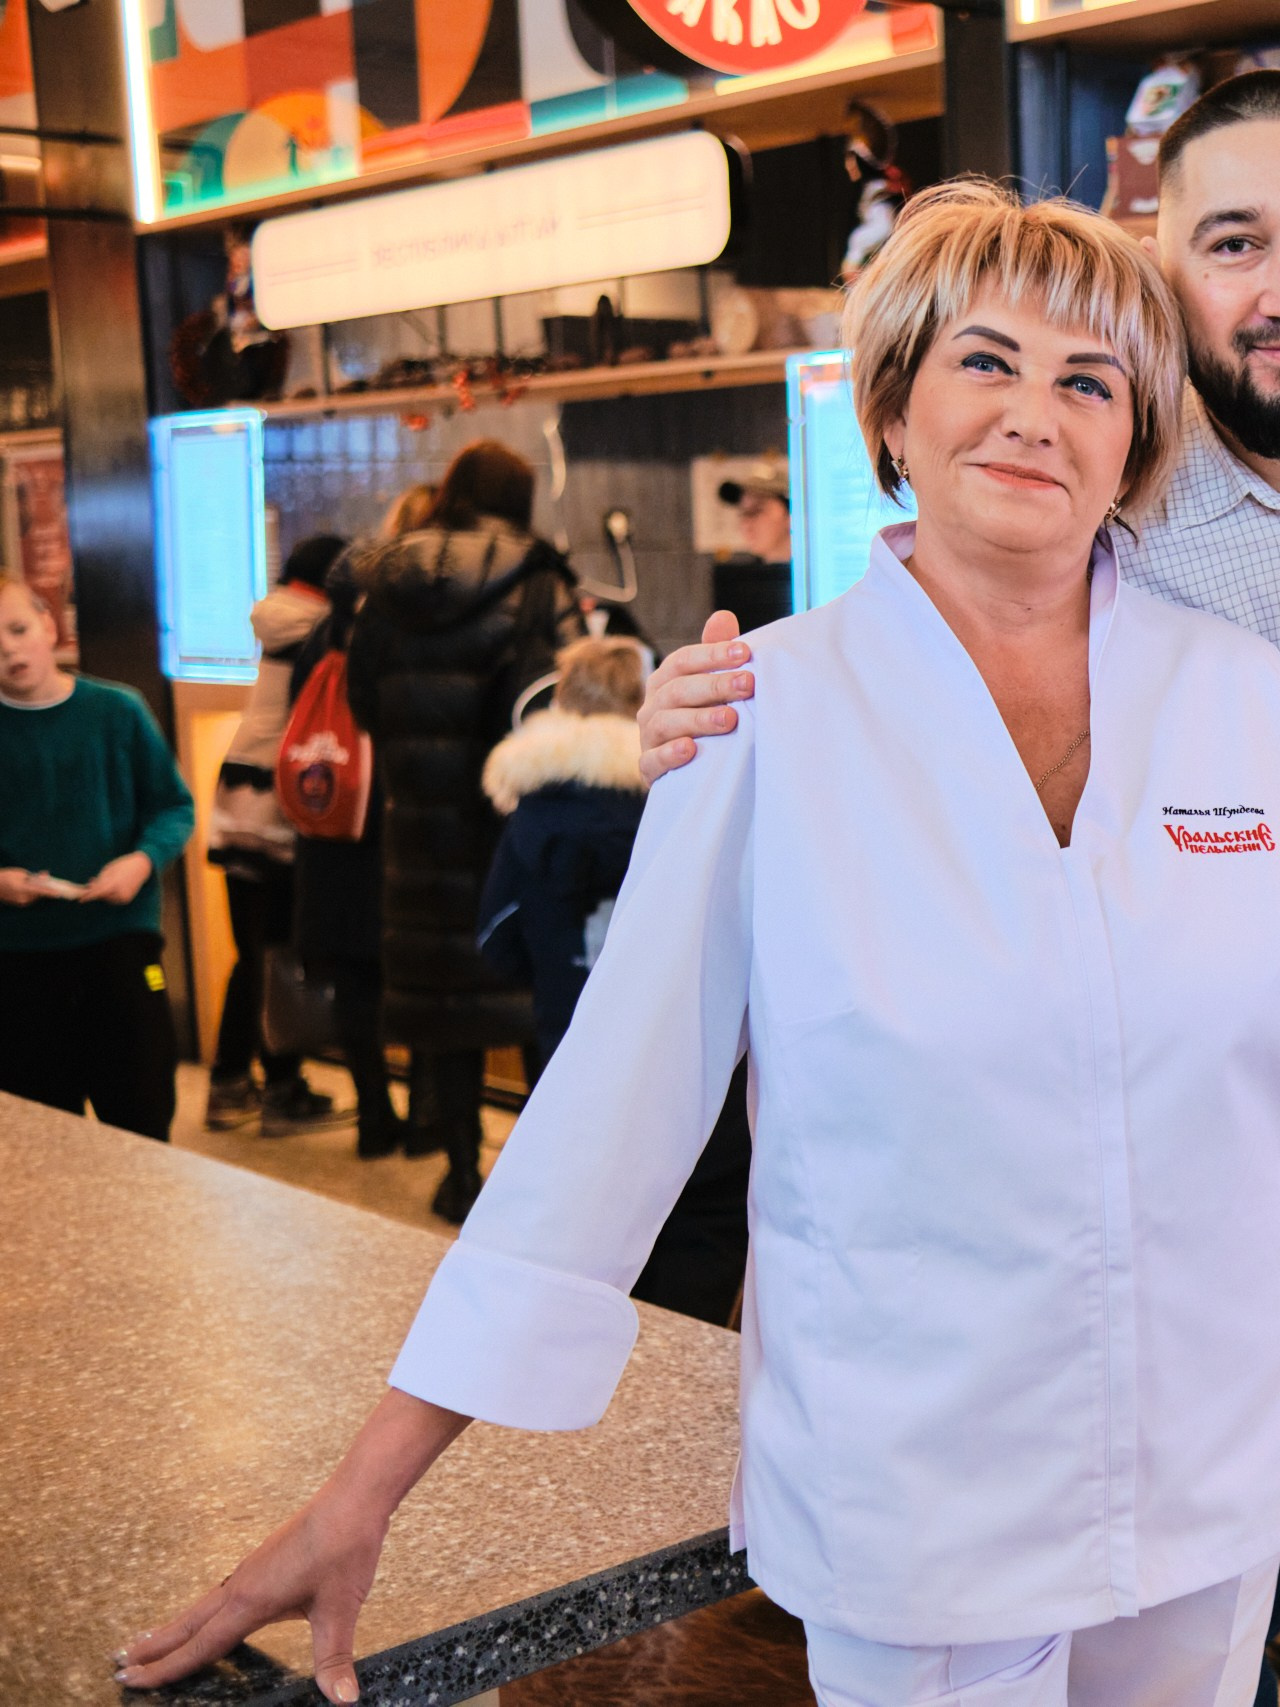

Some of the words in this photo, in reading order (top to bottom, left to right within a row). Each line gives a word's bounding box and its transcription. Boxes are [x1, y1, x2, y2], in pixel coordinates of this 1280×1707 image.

[1162, 805, 1211, 816] Наталья
[1213, 805, 1264, 818] Шундеева
[1163, 823, 1275, 852] Уральские
